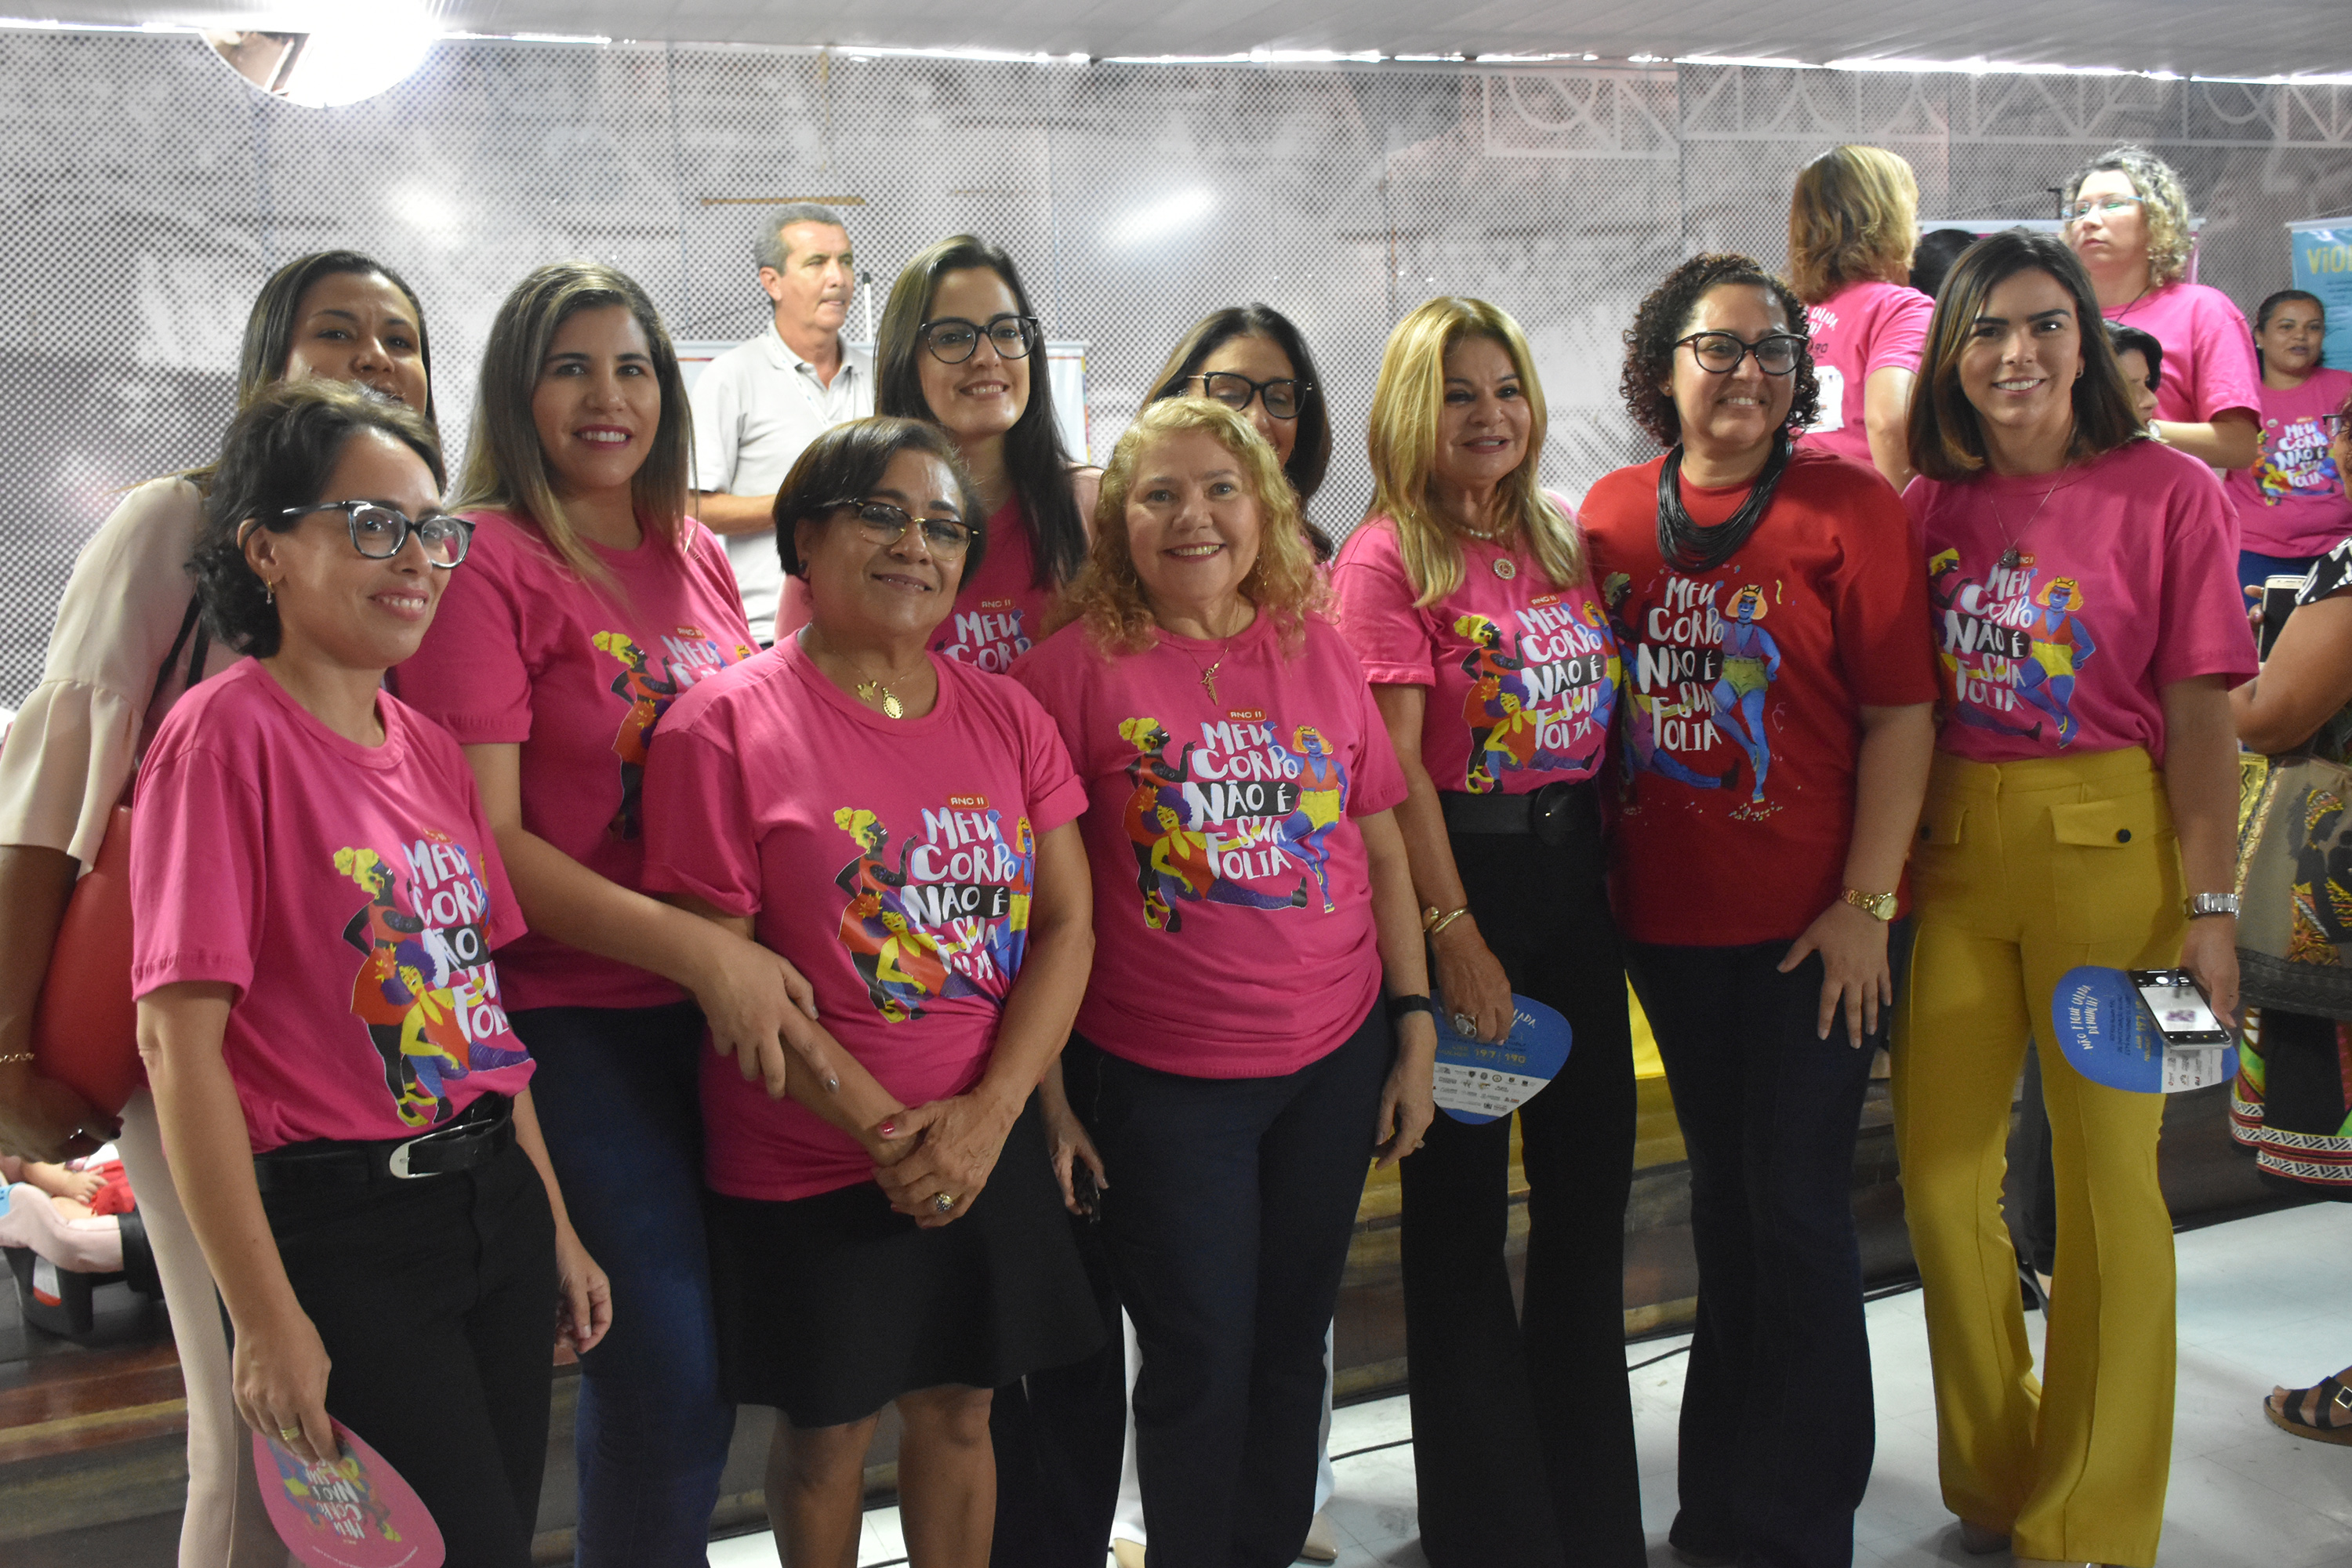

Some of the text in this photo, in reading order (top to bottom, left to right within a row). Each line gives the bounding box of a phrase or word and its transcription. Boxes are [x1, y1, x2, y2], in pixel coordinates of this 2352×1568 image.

[1664, 575, 1715, 614] MEU
[1985, 564, 2031, 601] MEU
[954, 611, 1019, 647] MEU
[1515, 607, 1573, 636] MEU
[1648, 607, 1724, 648] CORPO
[1944, 610, 2025, 657] NÃO É
[661, 634, 721, 669] MEU
[944, 637, 1033, 674] CORP
[1521, 624, 1602, 662] CORPO
[1520, 653, 1602, 710] NÃO É
[1637, 642, 1717, 694] NÃO É
[1956, 658, 2024, 711] FOLIA
[1979, 653, 2027, 688] SUA
[1560, 685, 1599, 721] SUA
[1677, 681, 1722, 718] SUA
[1201, 720, 1272, 755] MEU
[1651, 696, 1722, 752] FOLIA
[1192, 746, 1298, 782] CORPO
[950, 797, 973, 806] ANO
[1182, 779, 1292, 832] NÃO É
[922, 807, 996, 850] MEU
[1237, 815, 1287, 848] SUA
[401, 839, 470, 890] MEU
[912, 843, 1015, 884] CORPO
[1205, 832, 1292, 880] FOLIA
[413, 877, 488, 925] CORP
[901, 882, 1008, 934] NÃO É
[953, 916, 999, 954] SUA
[2077, 1033, 2093, 1050] NÃO
